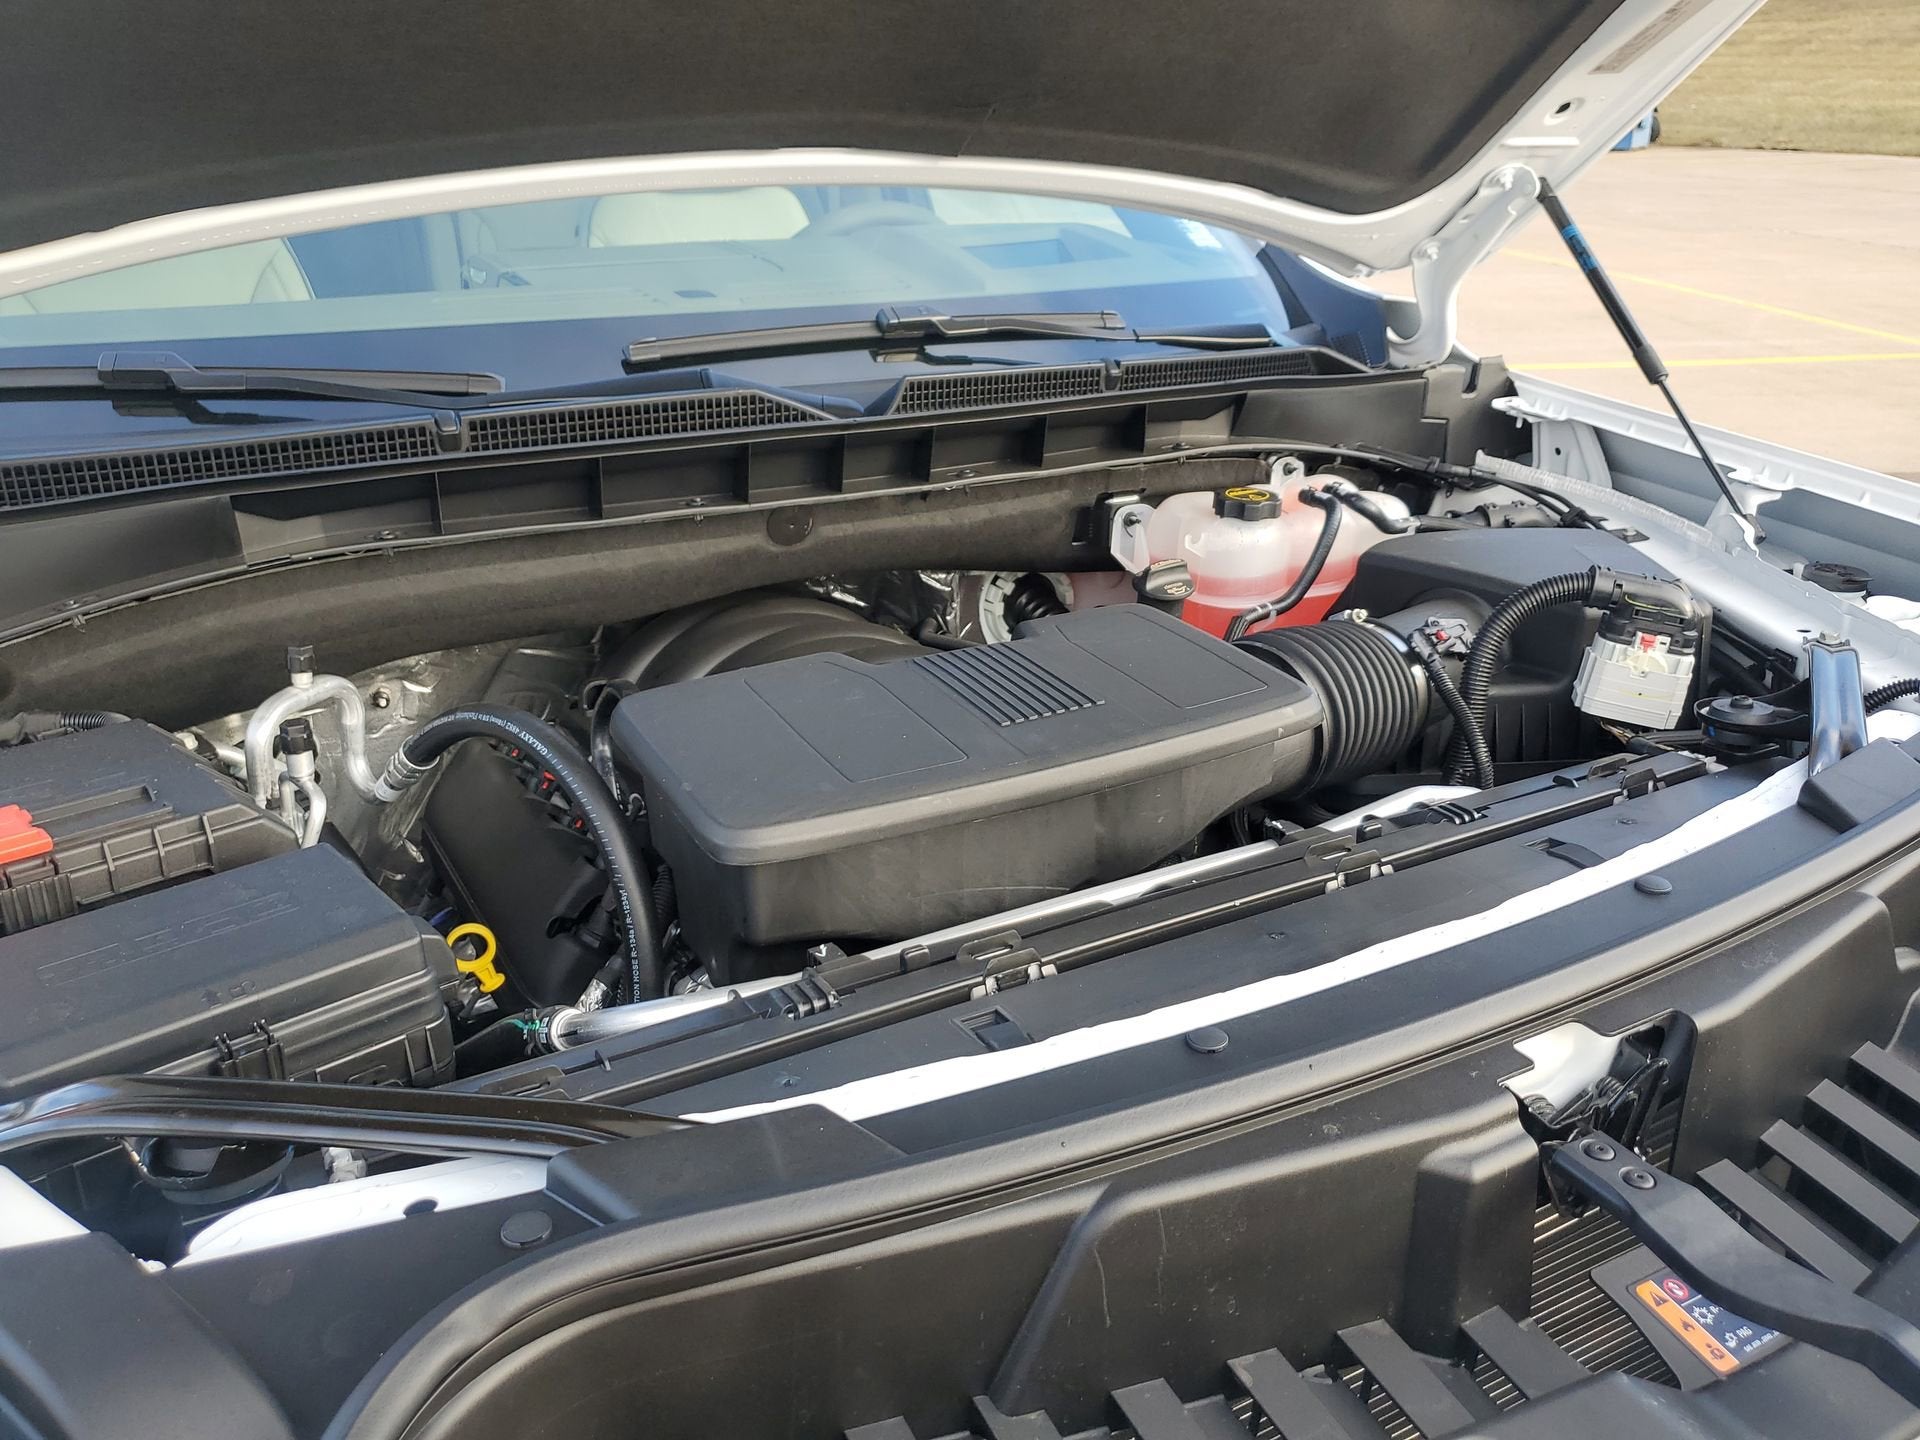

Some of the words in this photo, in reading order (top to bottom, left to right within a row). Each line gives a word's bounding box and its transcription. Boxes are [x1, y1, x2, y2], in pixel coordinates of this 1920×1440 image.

[519, 731, 549, 756] GALAXY
[619, 889, 632, 923] R-1234yf
[629, 929, 637, 957] R-134a
[631, 959, 640, 982] HOSE
[1736, 1325, 1753, 1339] PAG
